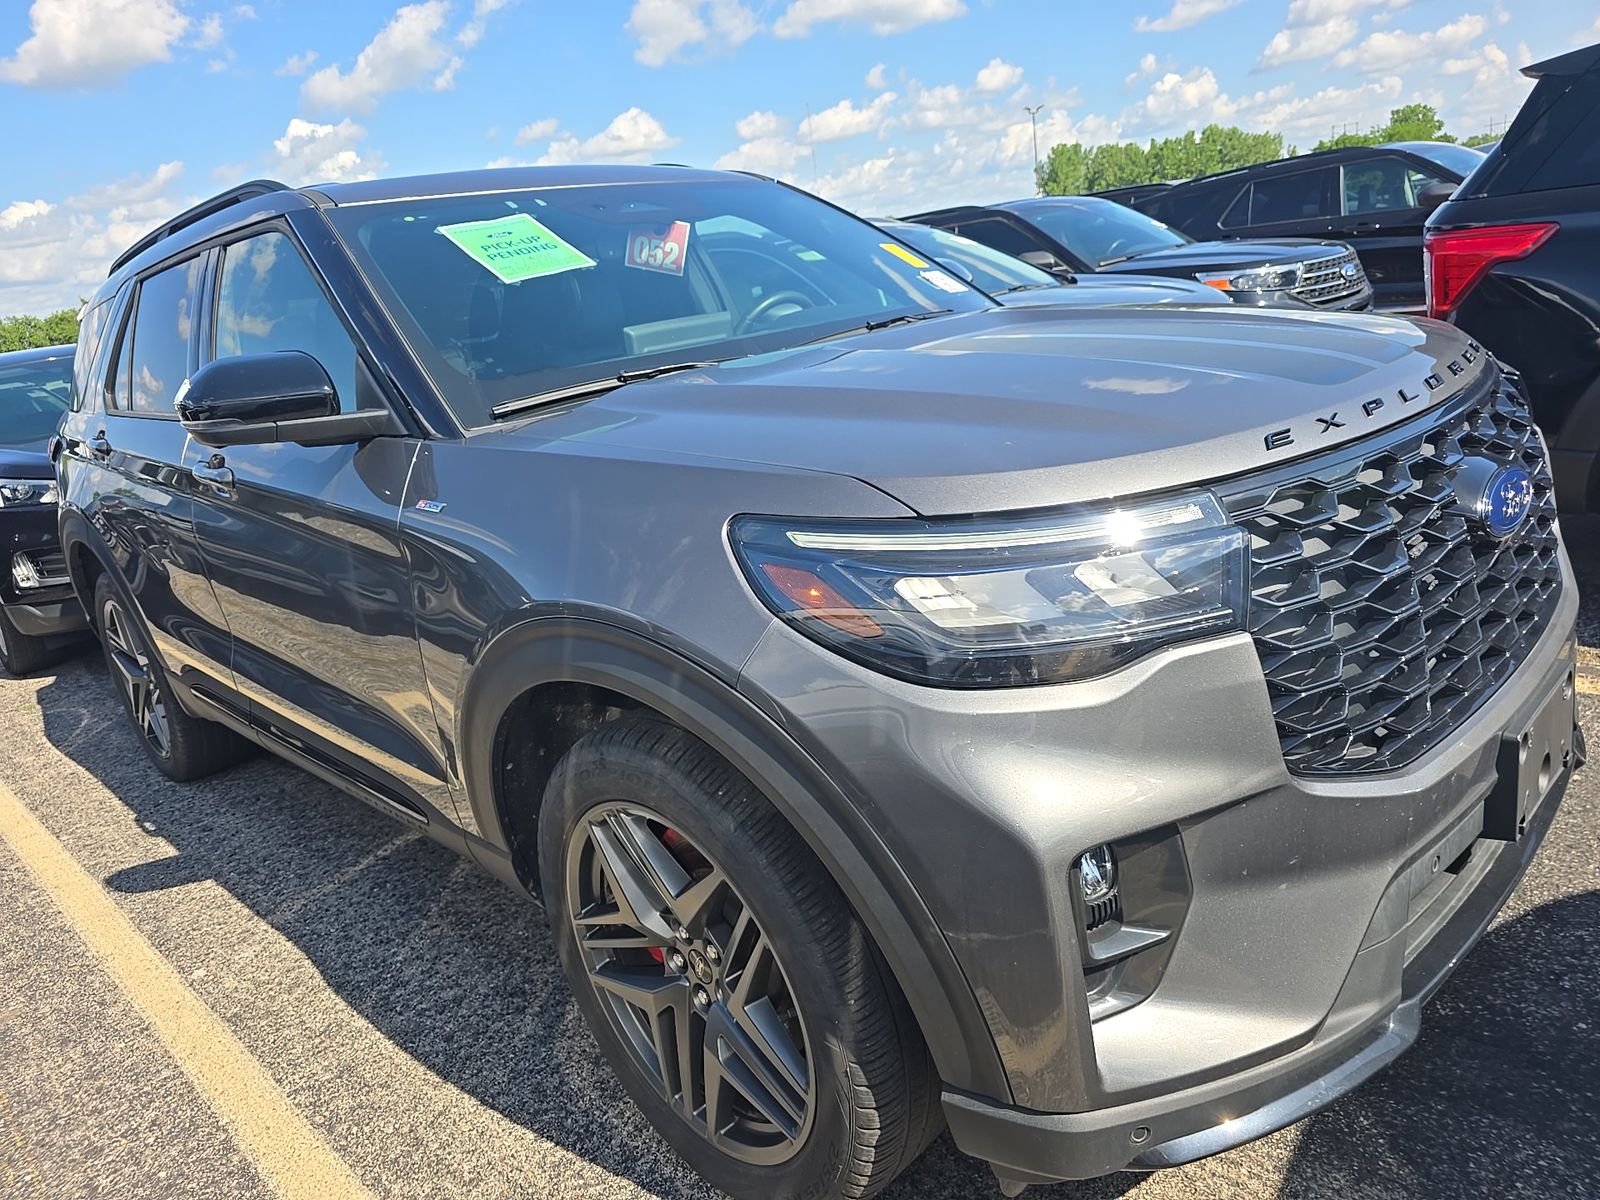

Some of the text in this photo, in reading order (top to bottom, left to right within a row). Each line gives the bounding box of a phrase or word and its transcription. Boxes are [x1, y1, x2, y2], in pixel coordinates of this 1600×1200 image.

[481, 235, 541, 252] PICK-UP
[487, 243, 558, 261] PENDING
[634, 236, 679, 271] 052
